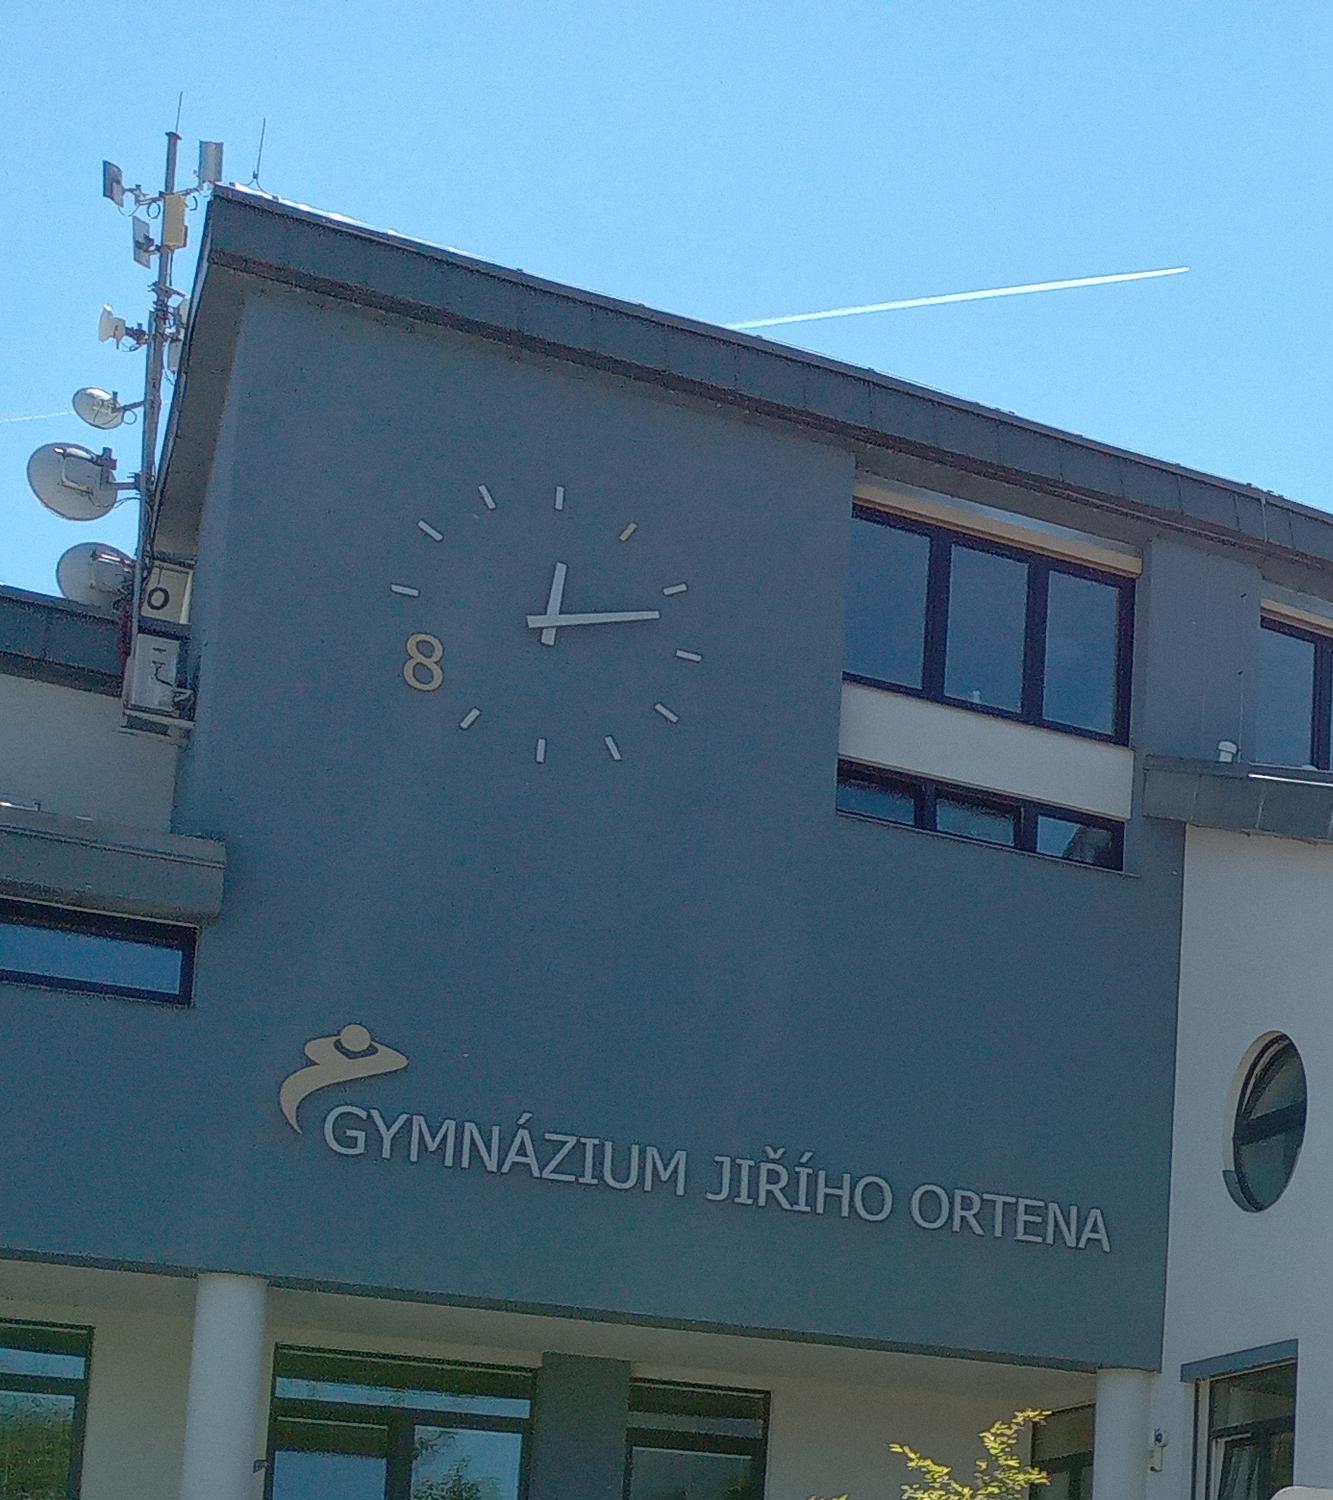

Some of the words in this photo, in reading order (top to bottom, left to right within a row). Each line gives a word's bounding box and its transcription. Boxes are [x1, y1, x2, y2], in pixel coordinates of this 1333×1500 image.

[403, 632, 444, 692] 8
[323, 1104, 687, 1197] GYMNÁZIUM
[706, 1145, 894, 1223] JIŘÍHO
[909, 1183, 1112, 1254] ORTENA
